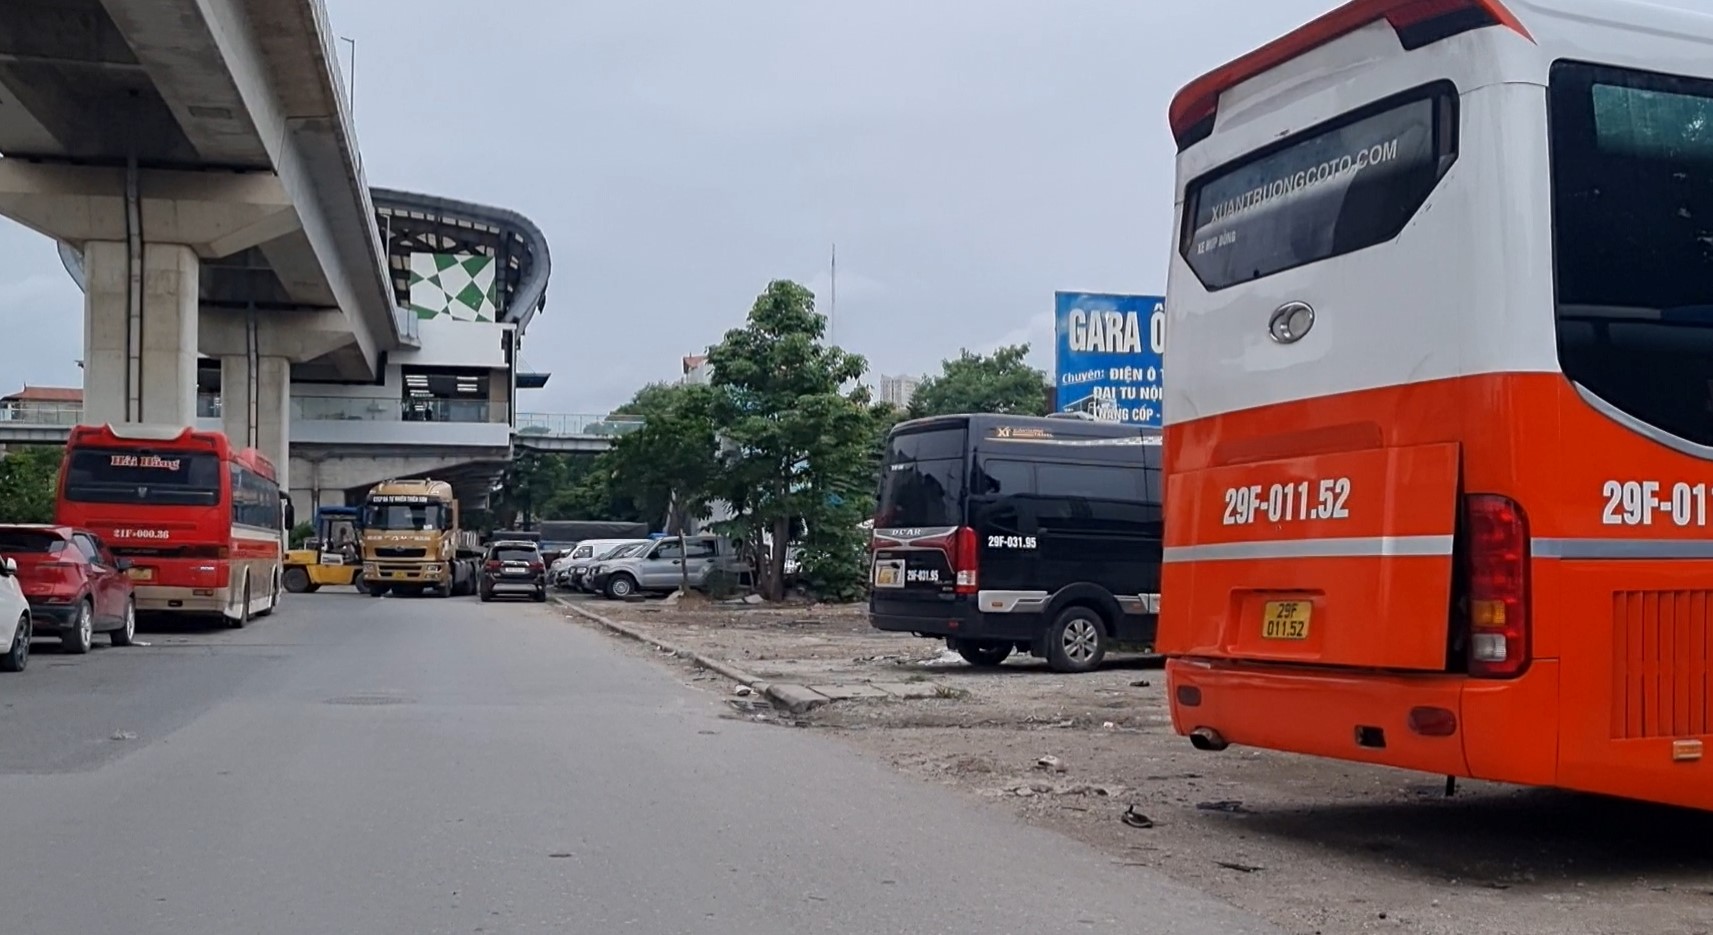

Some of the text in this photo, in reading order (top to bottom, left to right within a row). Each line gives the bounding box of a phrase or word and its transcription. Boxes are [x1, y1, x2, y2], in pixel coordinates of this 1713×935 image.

[1211, 139, 1399, 224] XUANTRUONGCOTO.COM
[1069, 302, 1165, 354] GARA Ô
[1109, 365, 1142, 384] ĐIỆN
[1147, 365, 1156, 381] Ô
[1119, 386, 1136, 400] TU
[1132, 404, 1154, 421] CỐP
[1223, 477, 1351, 526] 29F-011.52
[1602, 480, 1713, 526] 29F-01
[988, 535, 1037, 549] 29F-031.95
[907, 569, 939, 581] 29F-031.95
[1276, 602, 1299, 619] 29F
[1266, 620, 1305, 637] 011.52
